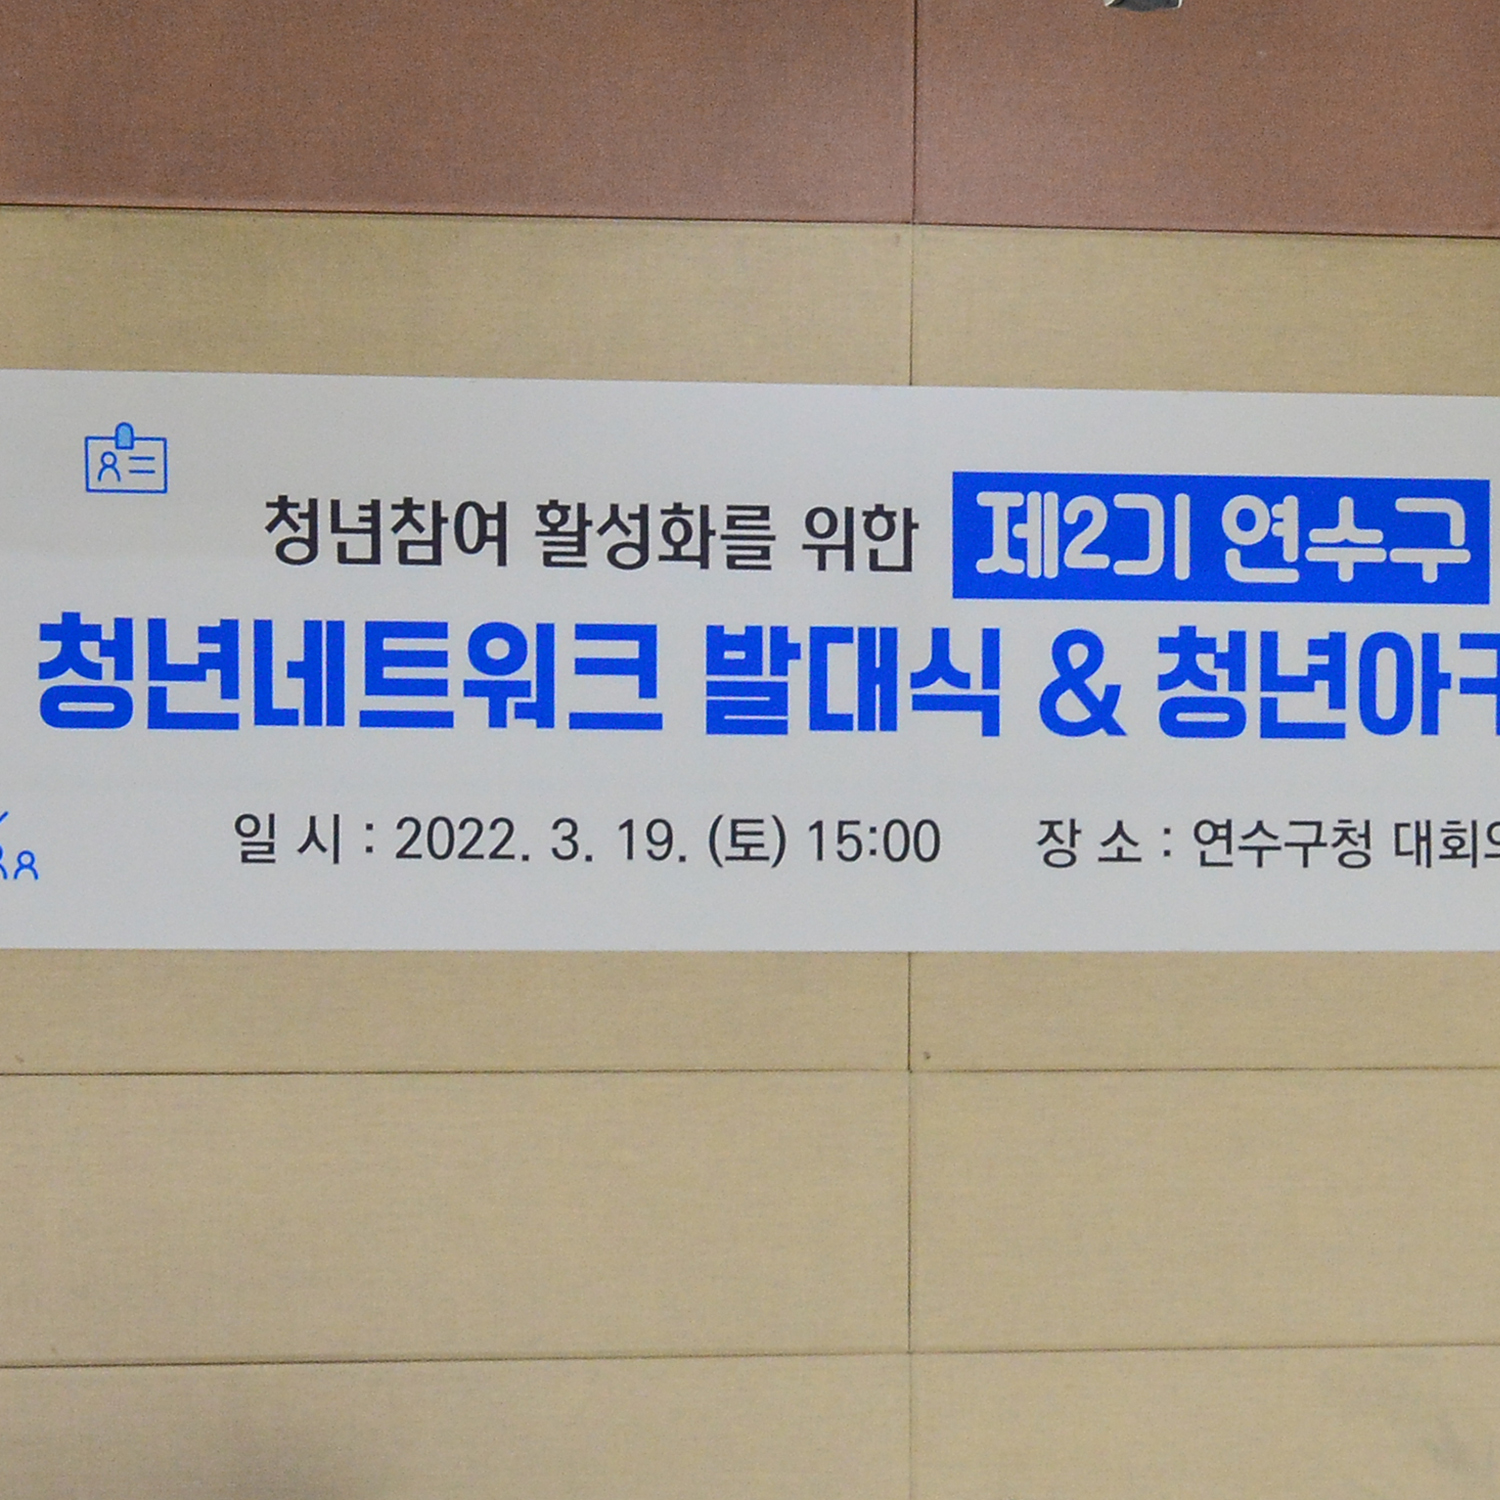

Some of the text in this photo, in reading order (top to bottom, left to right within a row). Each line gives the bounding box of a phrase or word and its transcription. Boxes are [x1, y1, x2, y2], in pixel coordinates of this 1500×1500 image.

[265, 490, 1472, 585] 청년참여 활성화를 위한 제2기 연수구
[39, 612, 665, 732] 청년네트워크
[706, 624, 1002, 738] 발대식
[1039, 629, 1128, 738] &
[235, 814, 277, 865] 일
[298, 814, 342, 866] 시
[396, 817, 532, 863] 2022.
[552, 818, 595, 863] 3.
[619, 819, 688, 864] 19.
[709, 815, 787, 869] (토)
[809, 819, 942, 864] 15:00
[1038, 819, 1083, 870] 장
[1098, 821, 1143, 865] 소
[1194, 819, 1373, 870] 연수구청
